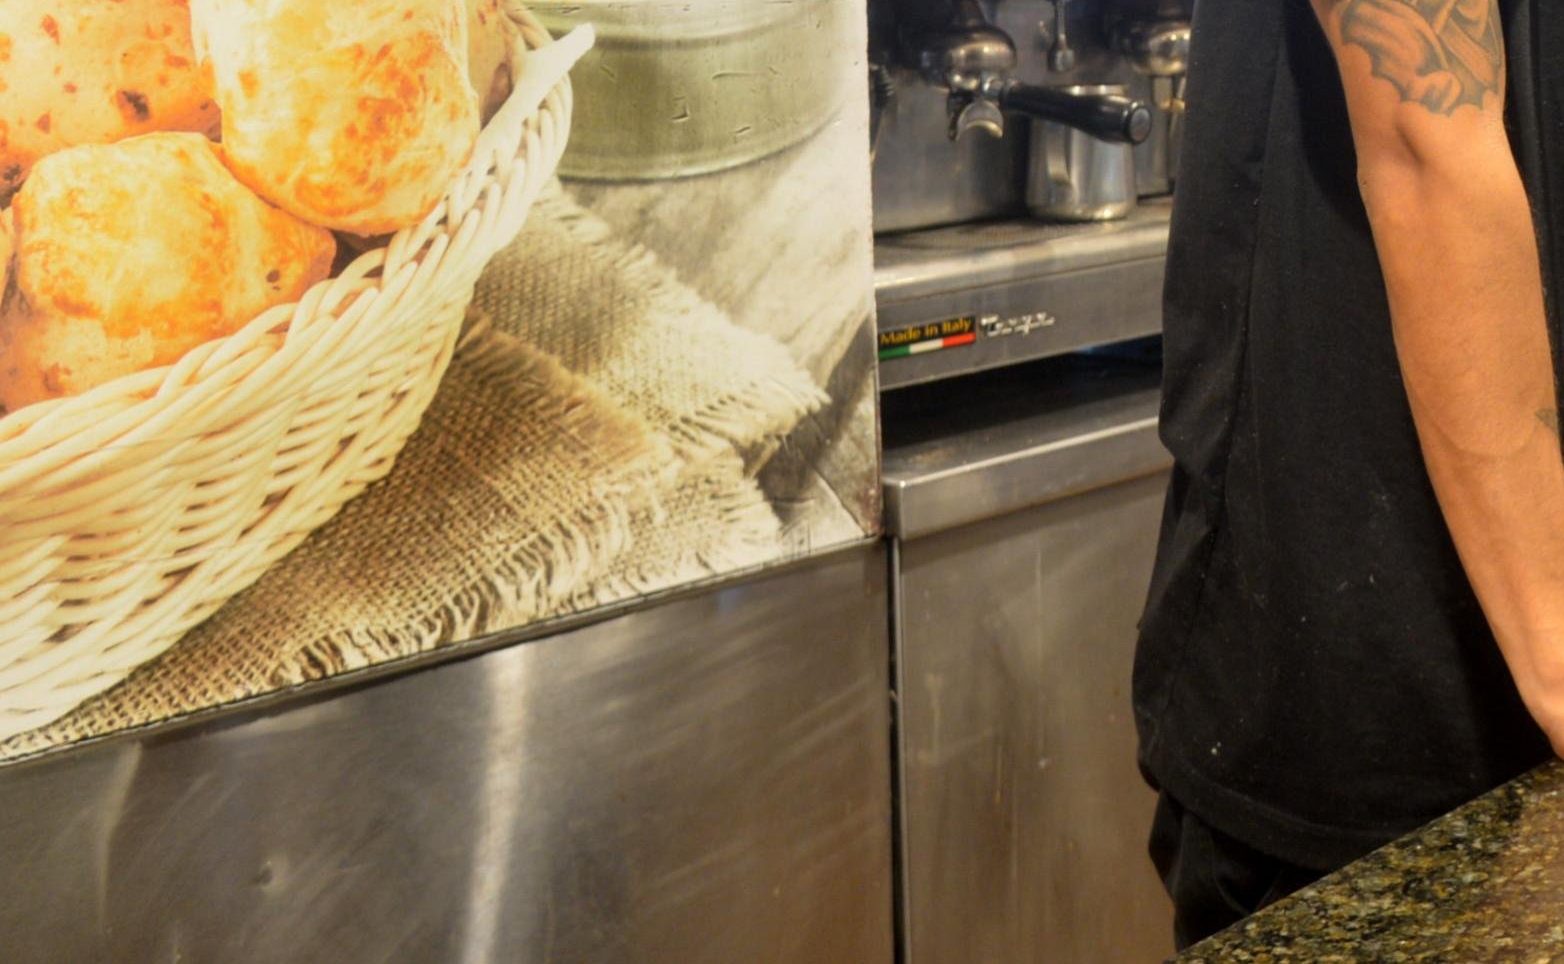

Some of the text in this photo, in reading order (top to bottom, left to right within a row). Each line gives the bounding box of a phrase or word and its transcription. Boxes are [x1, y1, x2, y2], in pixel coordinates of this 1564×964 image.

[880, 316, 972, 344] Made in Italy
